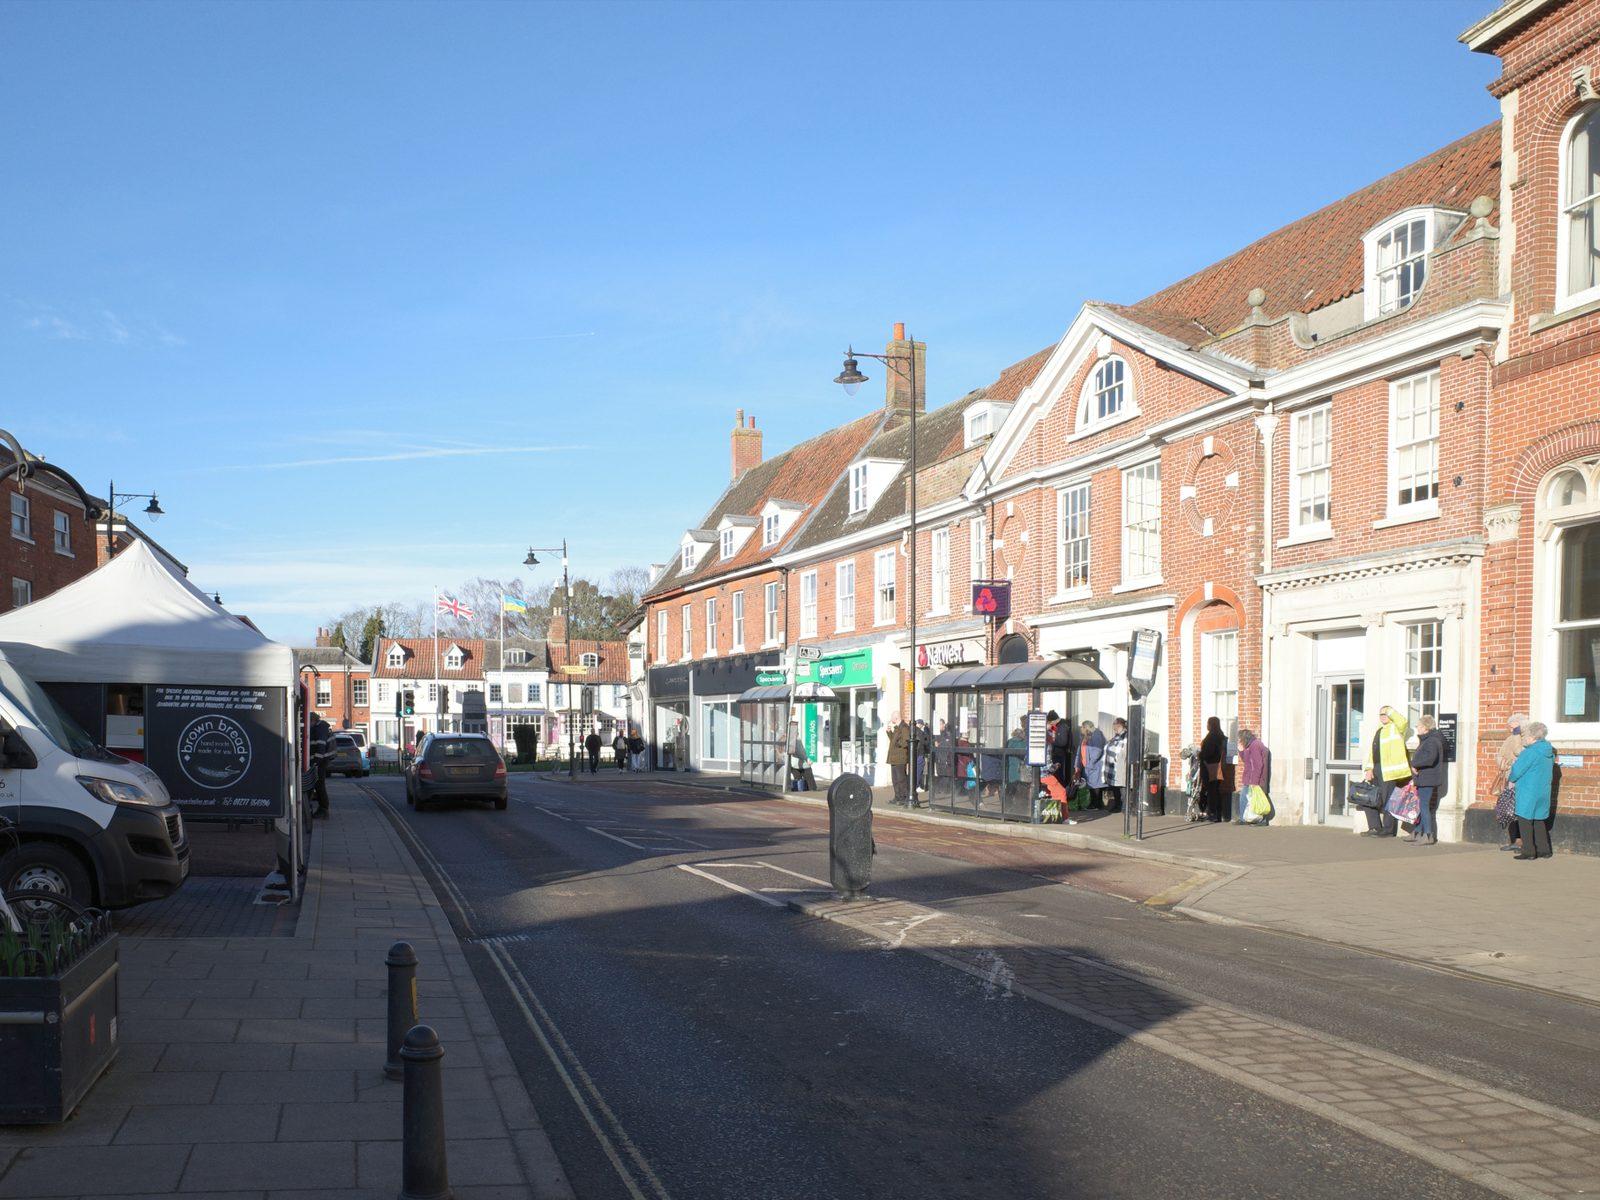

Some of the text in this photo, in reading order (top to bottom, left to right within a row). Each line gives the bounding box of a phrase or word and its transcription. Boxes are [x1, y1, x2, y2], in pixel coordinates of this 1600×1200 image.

[928, 643, 964, 666] NatWest
[820, 664, 843, 678] Specsavers
[181, 719, 248, 754] brown bread
